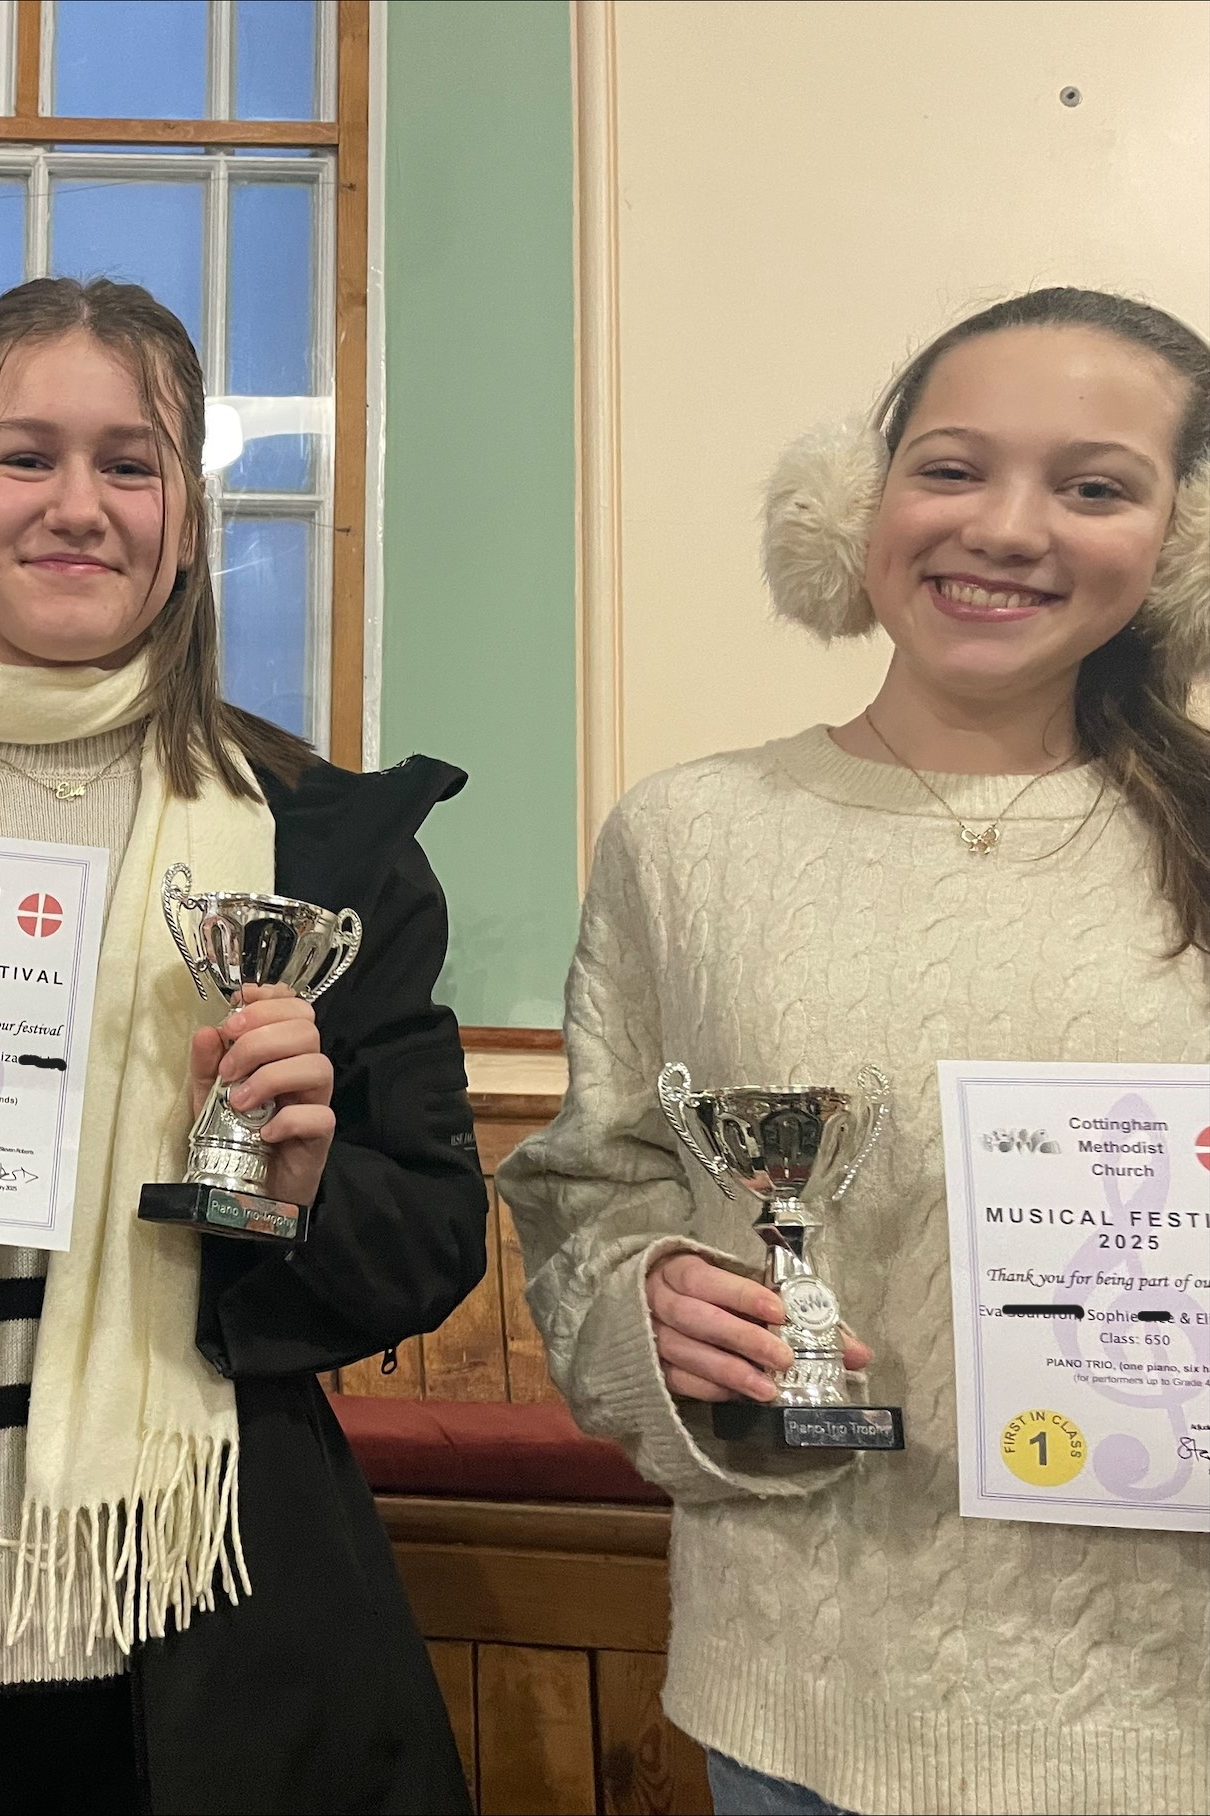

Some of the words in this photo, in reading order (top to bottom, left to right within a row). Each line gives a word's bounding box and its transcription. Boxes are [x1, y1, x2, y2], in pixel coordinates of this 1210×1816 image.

[13, 1021, 64, 1037] festival
[1069, 1117, 1169, 1133] Cottingham
[1078, 1140, 1164, 1154] Methodist
[1092, 1163, 1155, 1177] Church
[211, 1200, 239, 1216] Piano
[986, 1207, 1114, 1226] MUSICAL
[1099, 1234, 1159, 1250] 2025
[987, 1268, 1036, 1286] Thank
[1035, 1273, 1065, 1287] you
[1065, 1270, 1090, 1288] for
[1096, 1271, 1134, 1290] being
[1138, 1276, 1170, 1291] part
[1174, 1274, 1193, 1292] of
[979, 1305, 1003, 1318] Eva
[1087, 1309, 1139, 1324] Sophie
[1180, 1313, 1191, 1324] &
[1196, 1312, 1210, 1325] El
[1100, 1332, 1140, 1345] Class:
[1145, 1335, 1171, 1346] 650
[1047, 1358, 1082, 1369] PIANO
[1086, 1360, 1116, 1371] TRIO,
[1119, 1362, 1143, 1372] (one
[1147, 1363, 1181, 1374] piano,
[1183, 1364, 1200, 1373] six
[1073, 1374, 1089, 1384] (for
[1091, 1374, 1144, 1386] performers
[1161, 1378, 1171, 1386] to
[1173, 1378, 1202, 1387] Grade
[1004, 1415, 1026, 1454] FIRST
[1030, 1411, 1045, 1422] IN
[1052, 1415, 1082, 1459] CLASS
[1029, 1431, 1047, 1466] 1
